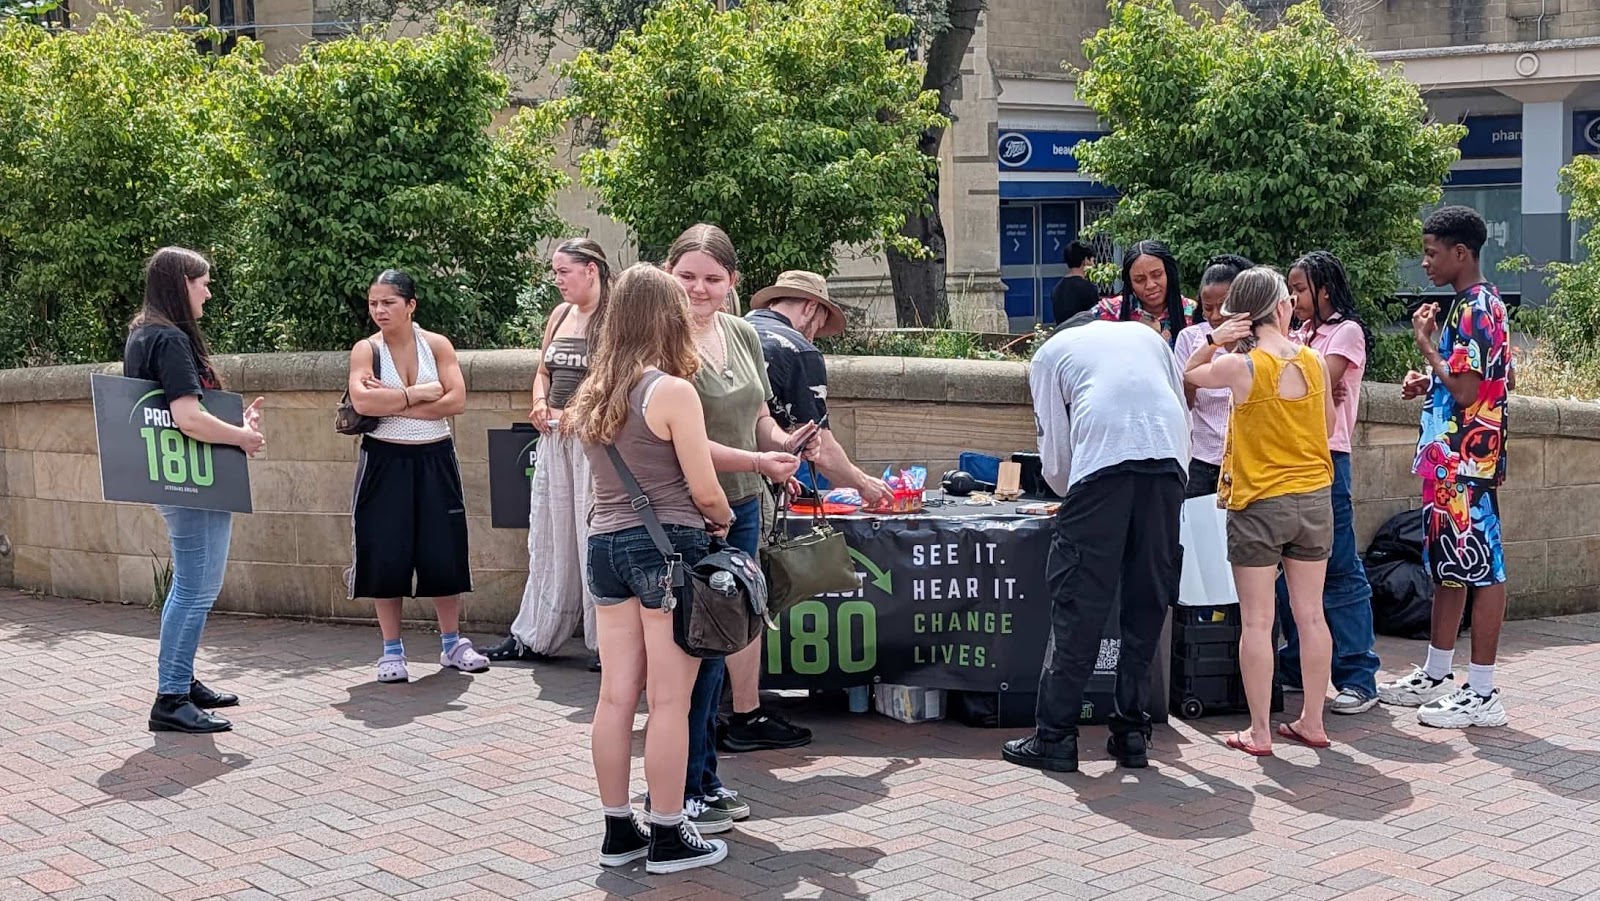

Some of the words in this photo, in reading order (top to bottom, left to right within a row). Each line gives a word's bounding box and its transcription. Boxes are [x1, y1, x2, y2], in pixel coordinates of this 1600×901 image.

[144, 407, 178, 429] PRO
[140, 427, 214, 487] 180
[913, 543, 959, 566] SEE
[975, 542, 1005, 565] IT.
[913, 578, 979, 600] HEAR
[994, 578, 1025, 600] IT.
[914, 612, 1013, 634] CHANGE
[766, 600, 877, 675] 180
[914, 644, 997, 669] LIVES.
